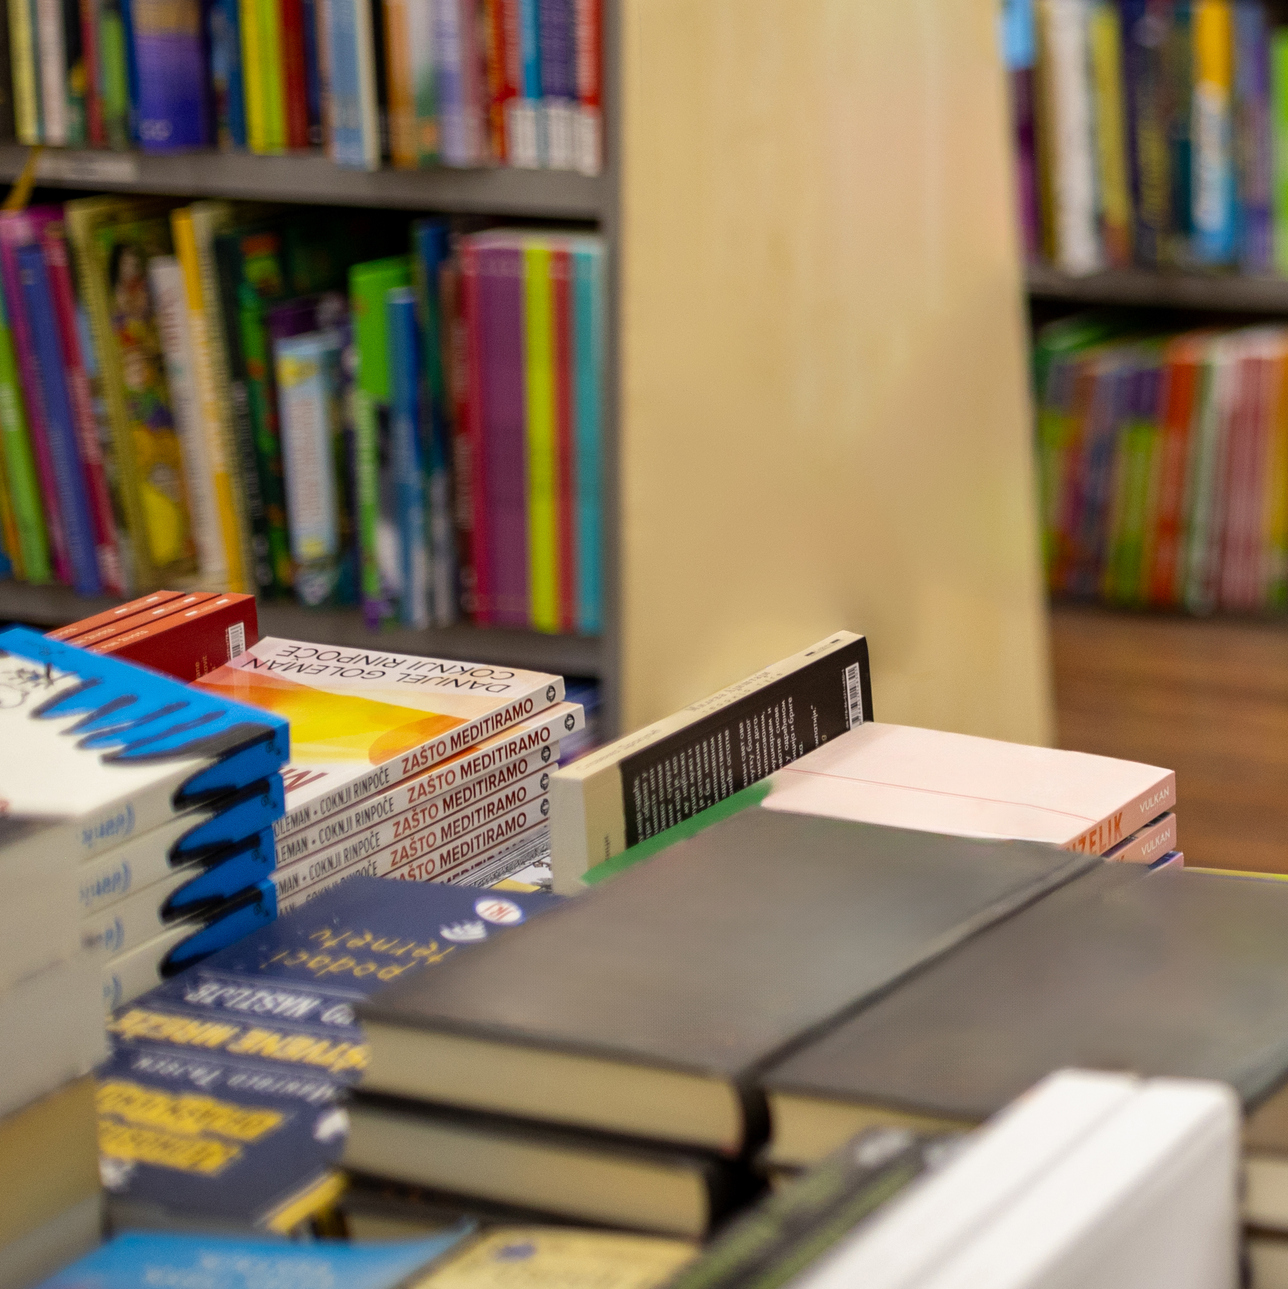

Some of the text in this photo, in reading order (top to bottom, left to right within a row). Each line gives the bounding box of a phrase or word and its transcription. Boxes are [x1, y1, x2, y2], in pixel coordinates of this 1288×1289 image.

[241, 657, 387, 681] GOLEMAN
[275, 644, 516, 681] COKNJI RINPOČE
[396, 671, 512, 694] DANIJEL
[353, 767, 391, 799] RINPOČE
[401, 741, 447, 776] ZAŠTO
[450, 698, 534, 752] MEDITIRAMO
[355, 796, 395, 828] RINPOČE
[406, 769, 456, 805] ZAŠTO
[460, 726, 551, 780] MEDITIRAMO
[391, 804, 439, 839] ZAŠTO
[442, 758, 528, 816] MEDITIRAMO
[1140, 785, 1170, 813] VULKAN
[389, 832, 437, 868] ZAŠTO
[440, 785, 527, 841] MEDITIRAMO
[439, 812, 527, 870] MEDITIRAMO
[1141, 828, 1171, 856] VULKAN
